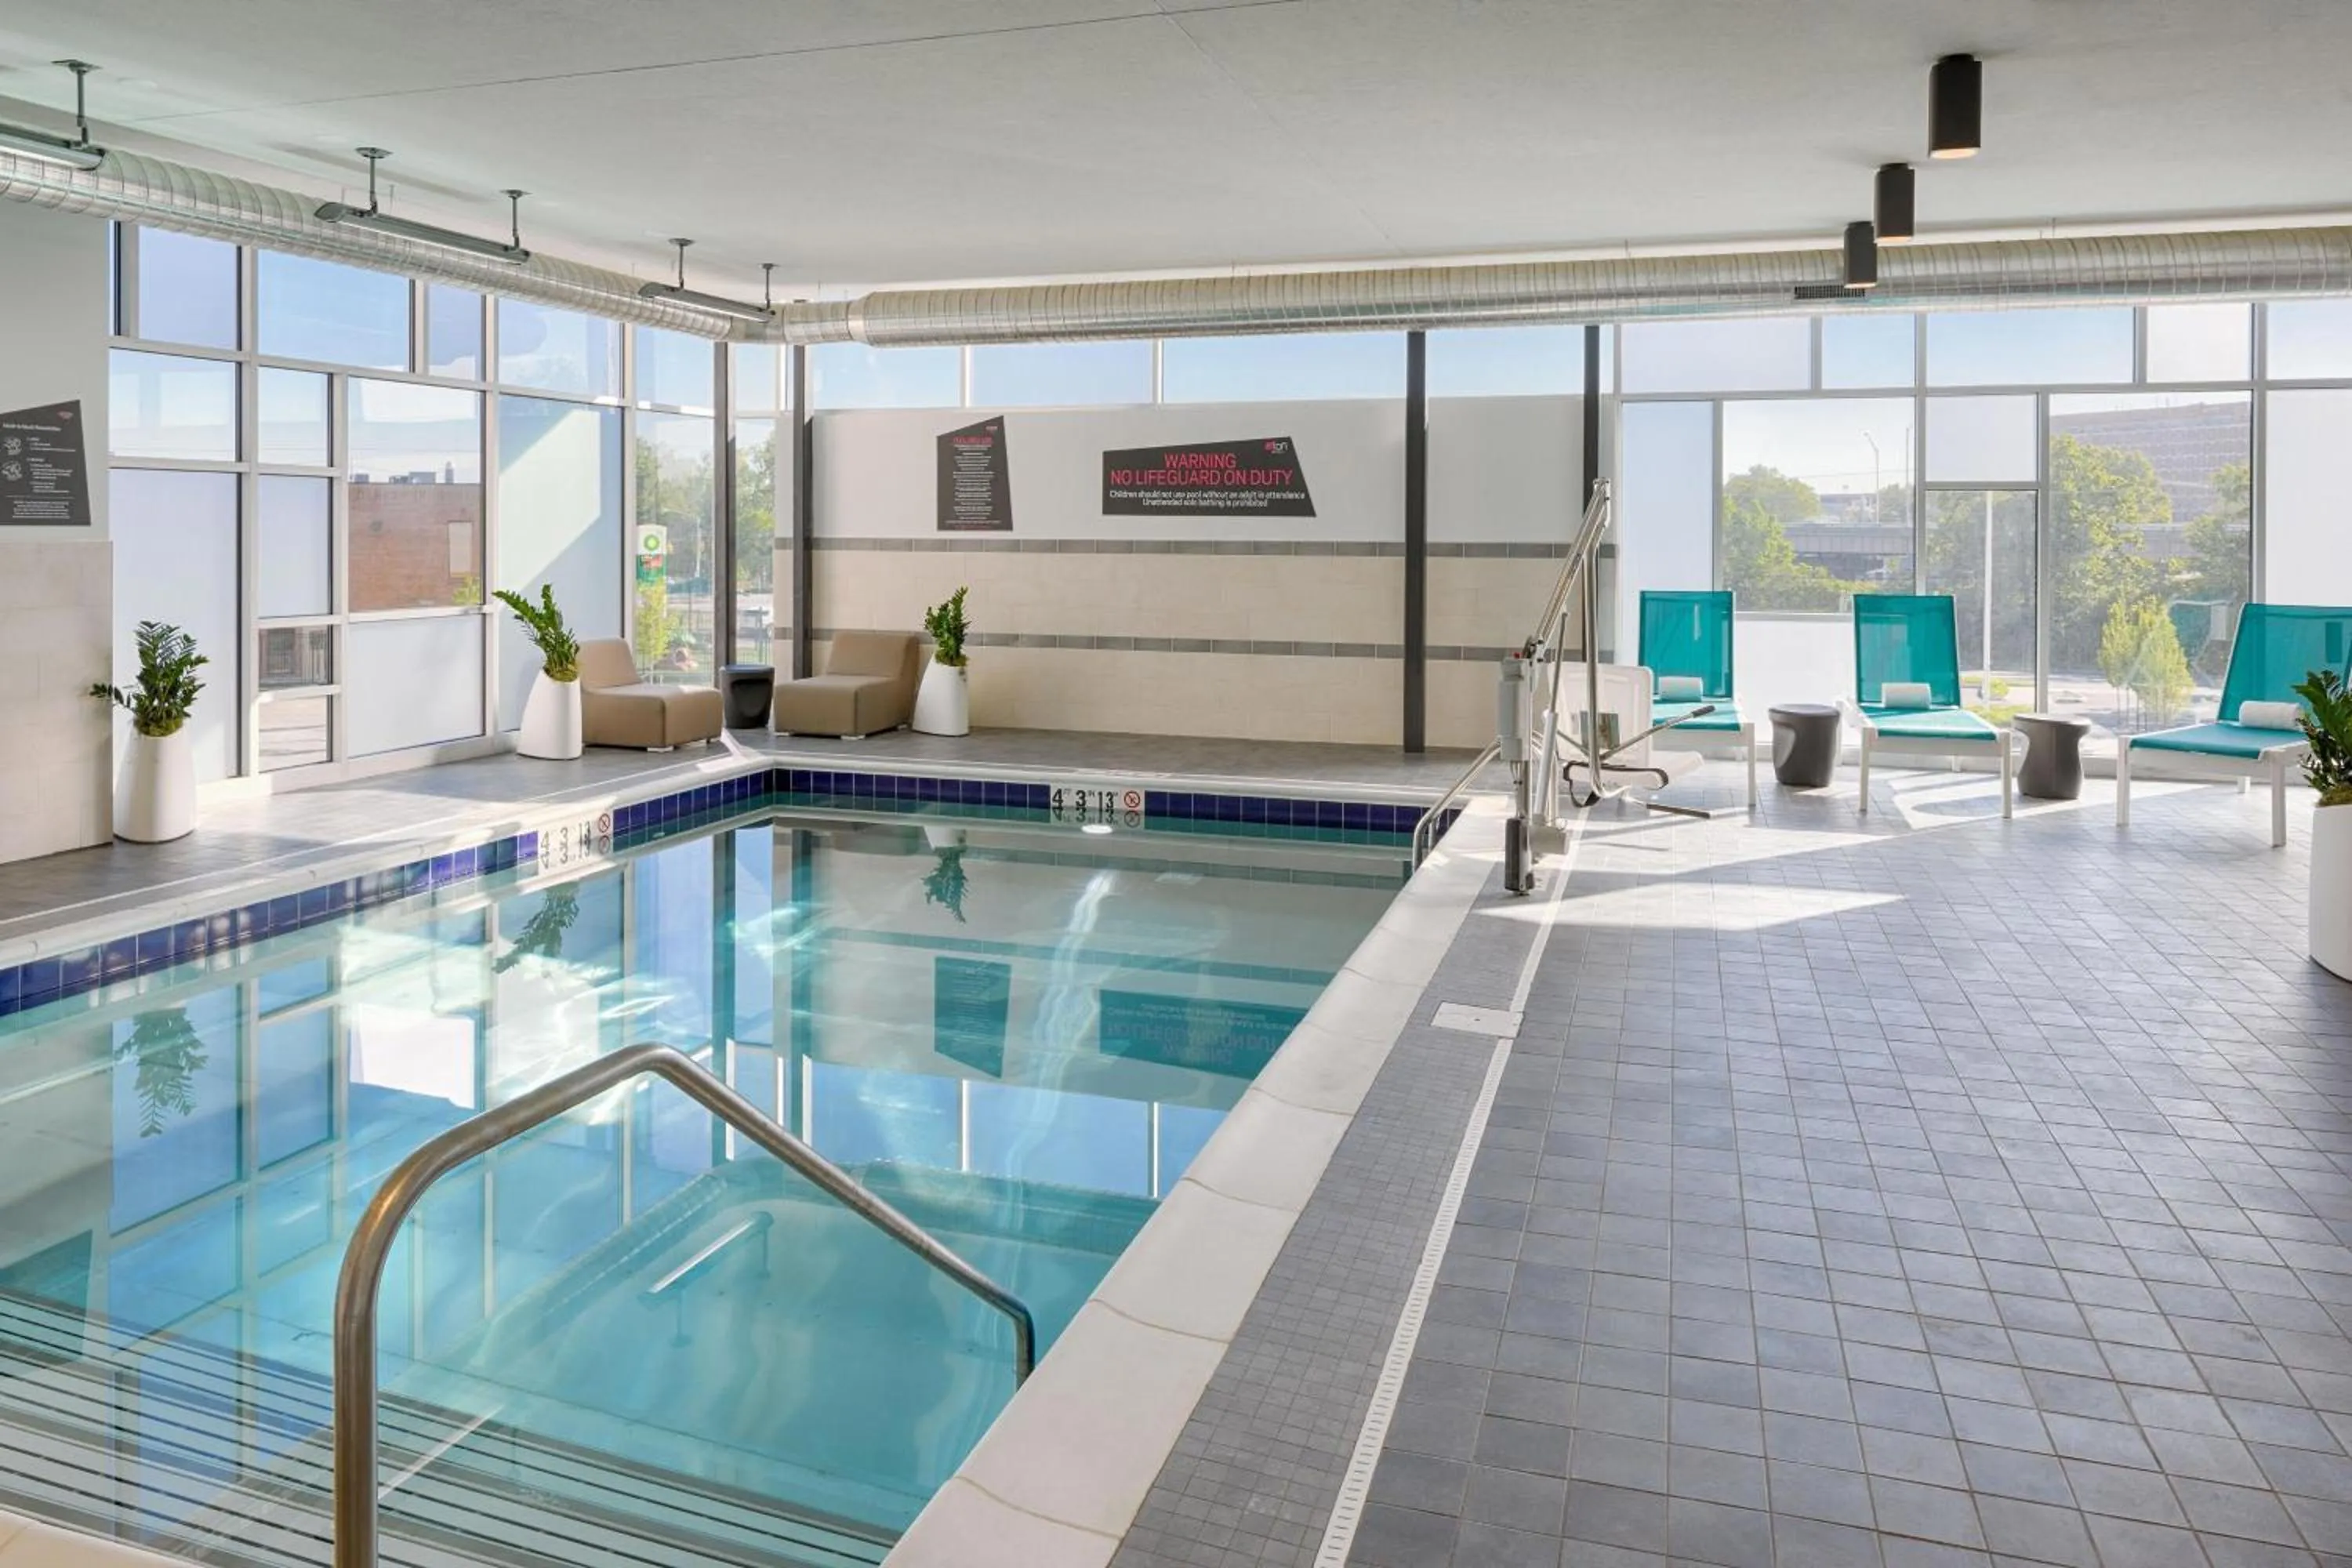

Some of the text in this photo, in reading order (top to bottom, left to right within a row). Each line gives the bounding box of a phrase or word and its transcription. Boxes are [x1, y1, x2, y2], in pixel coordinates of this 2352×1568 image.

[1164, 452, 1236, 468] WARNING
[1111, 470, 1293, 485] NO LIFEGUARD ON DUTY
[1110, 490, 1137, 499] Children
[1052, 789, 1064, 808] 4
[1076, 789, 1086, 807] 3
